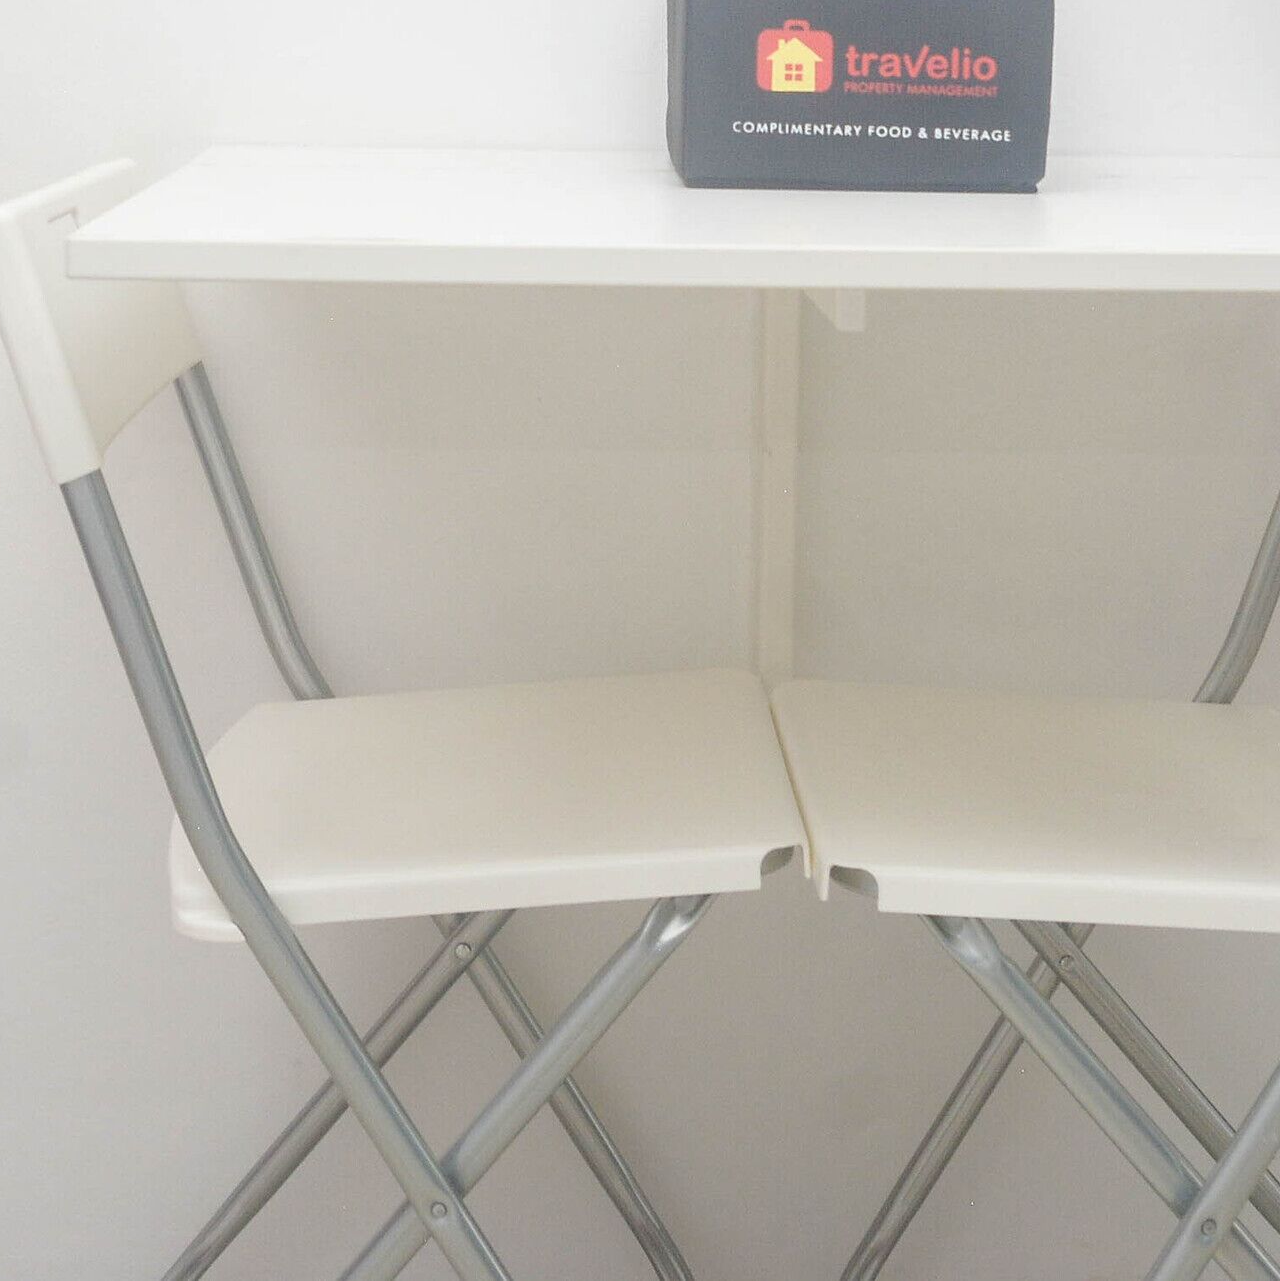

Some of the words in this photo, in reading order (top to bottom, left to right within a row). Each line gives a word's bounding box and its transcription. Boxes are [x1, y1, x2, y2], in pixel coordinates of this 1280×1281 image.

[845, 45, 998, 82] travelio
[844, 81, 904, 95] PROPERTY
[907, 83, 999, 98] MANAGEMENT
[732, 120, 862, 137] COMPLIMENTARY
[867, 125, 912, 139] FOOD
[917, 127, 928, 139] &
[934, 127, 1011, 142] BEVERAGE
